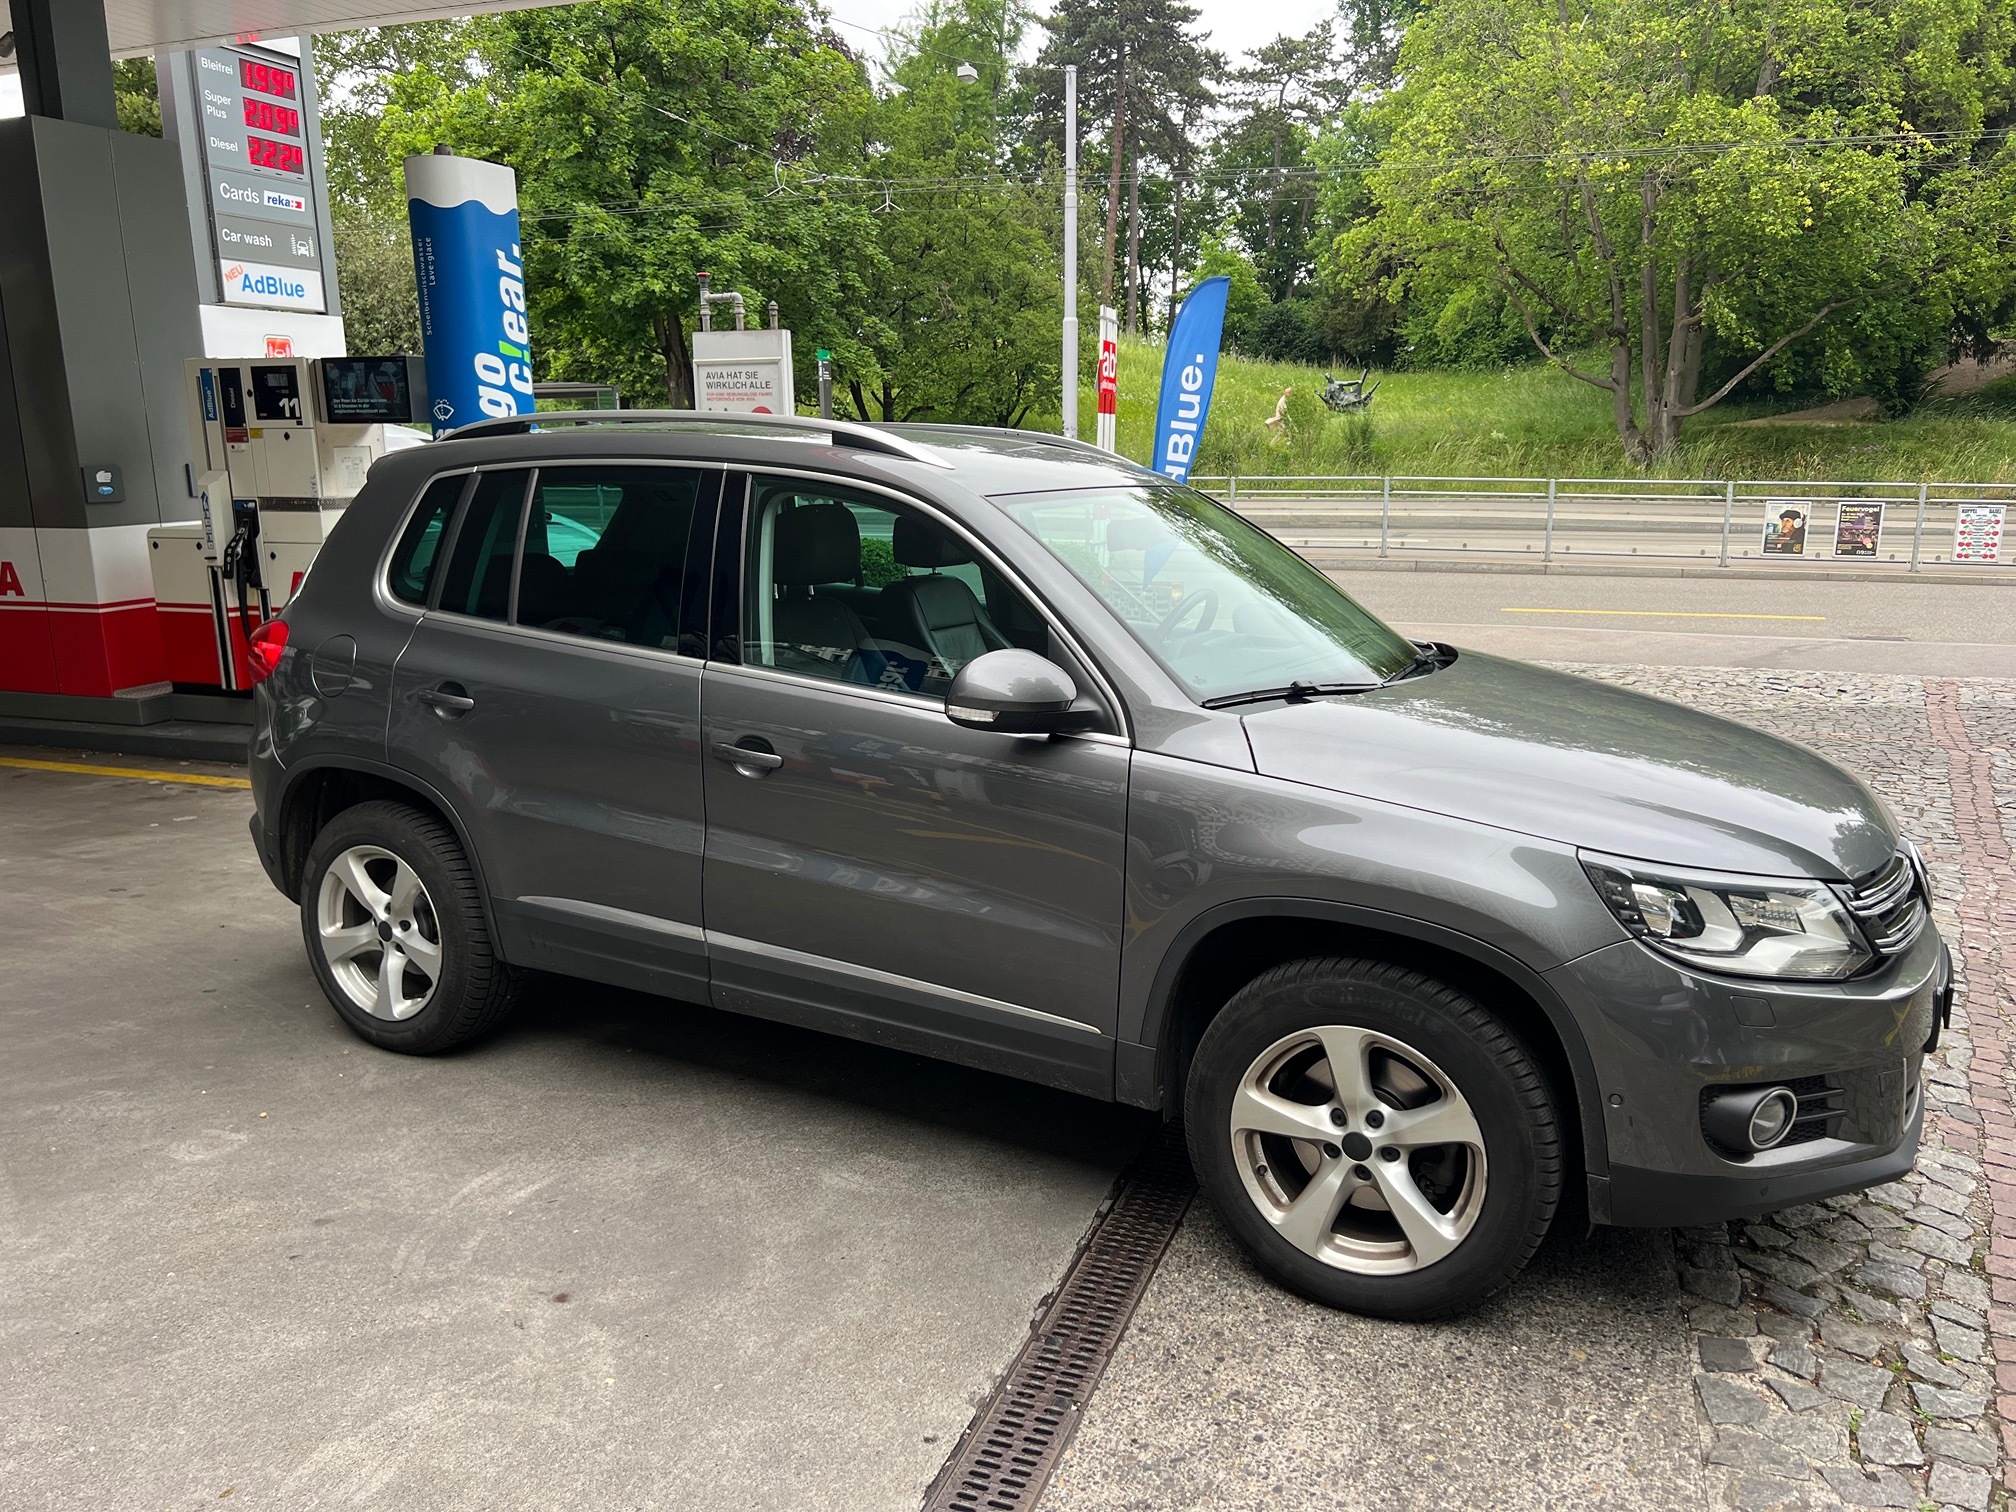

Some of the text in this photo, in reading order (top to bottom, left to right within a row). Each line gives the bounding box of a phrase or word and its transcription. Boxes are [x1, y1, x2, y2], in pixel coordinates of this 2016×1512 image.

[200, 57, 233, 75] Bleifrei
[204, 90, 232, 106] Super
[206, 105, 227, 119] Plus
[210, 136, 238, 152] Diesel
[220, 182, 260, 204] Cards
[221, 228, 273, 248] Car wash
[425, 237, 436, 286] Lave-glace
[224, 264, 244, 282] NEU
[242, 273, 305, 298] AdBlue
[417, 238, 433, 336] Scheibenwischwasser
[474, 352, 518, 418] go
[705, 371, 759, 380] AVIA HAT SIE
[706, 381, 774, 390] WIRKLICH ALLE.
[228, 387, 236, 409] Diesel
[279, 397, 301, 418] 11
[1841, 505, 1880, 514] Feuervogel
